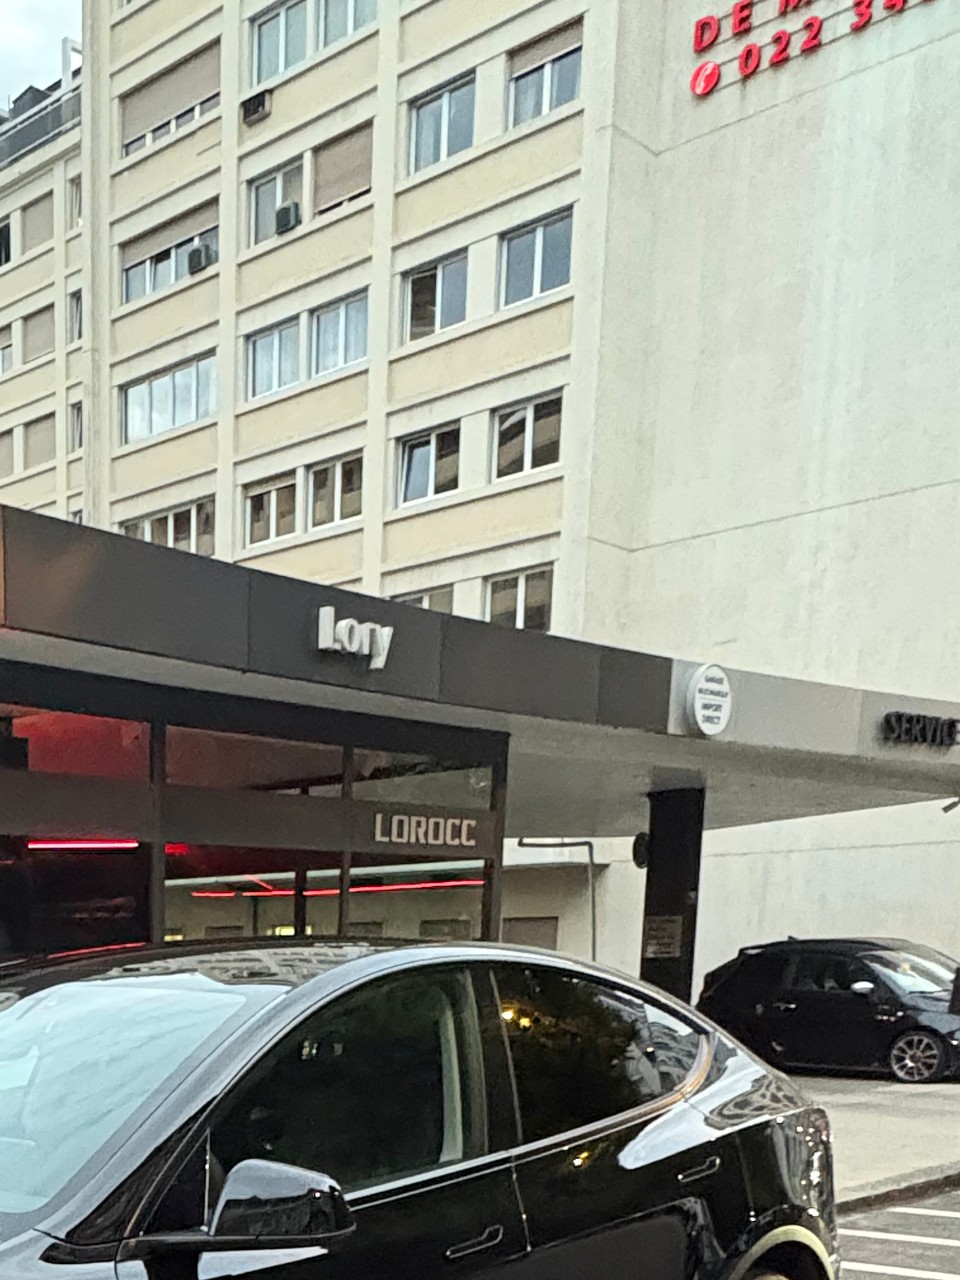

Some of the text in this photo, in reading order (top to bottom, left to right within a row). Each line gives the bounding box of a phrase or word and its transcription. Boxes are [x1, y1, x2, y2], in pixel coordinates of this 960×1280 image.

[738, 16, 823, 76] 022
[318, 606, 393, 669] Lory
[375, 813, 477, 846] LOROCC
